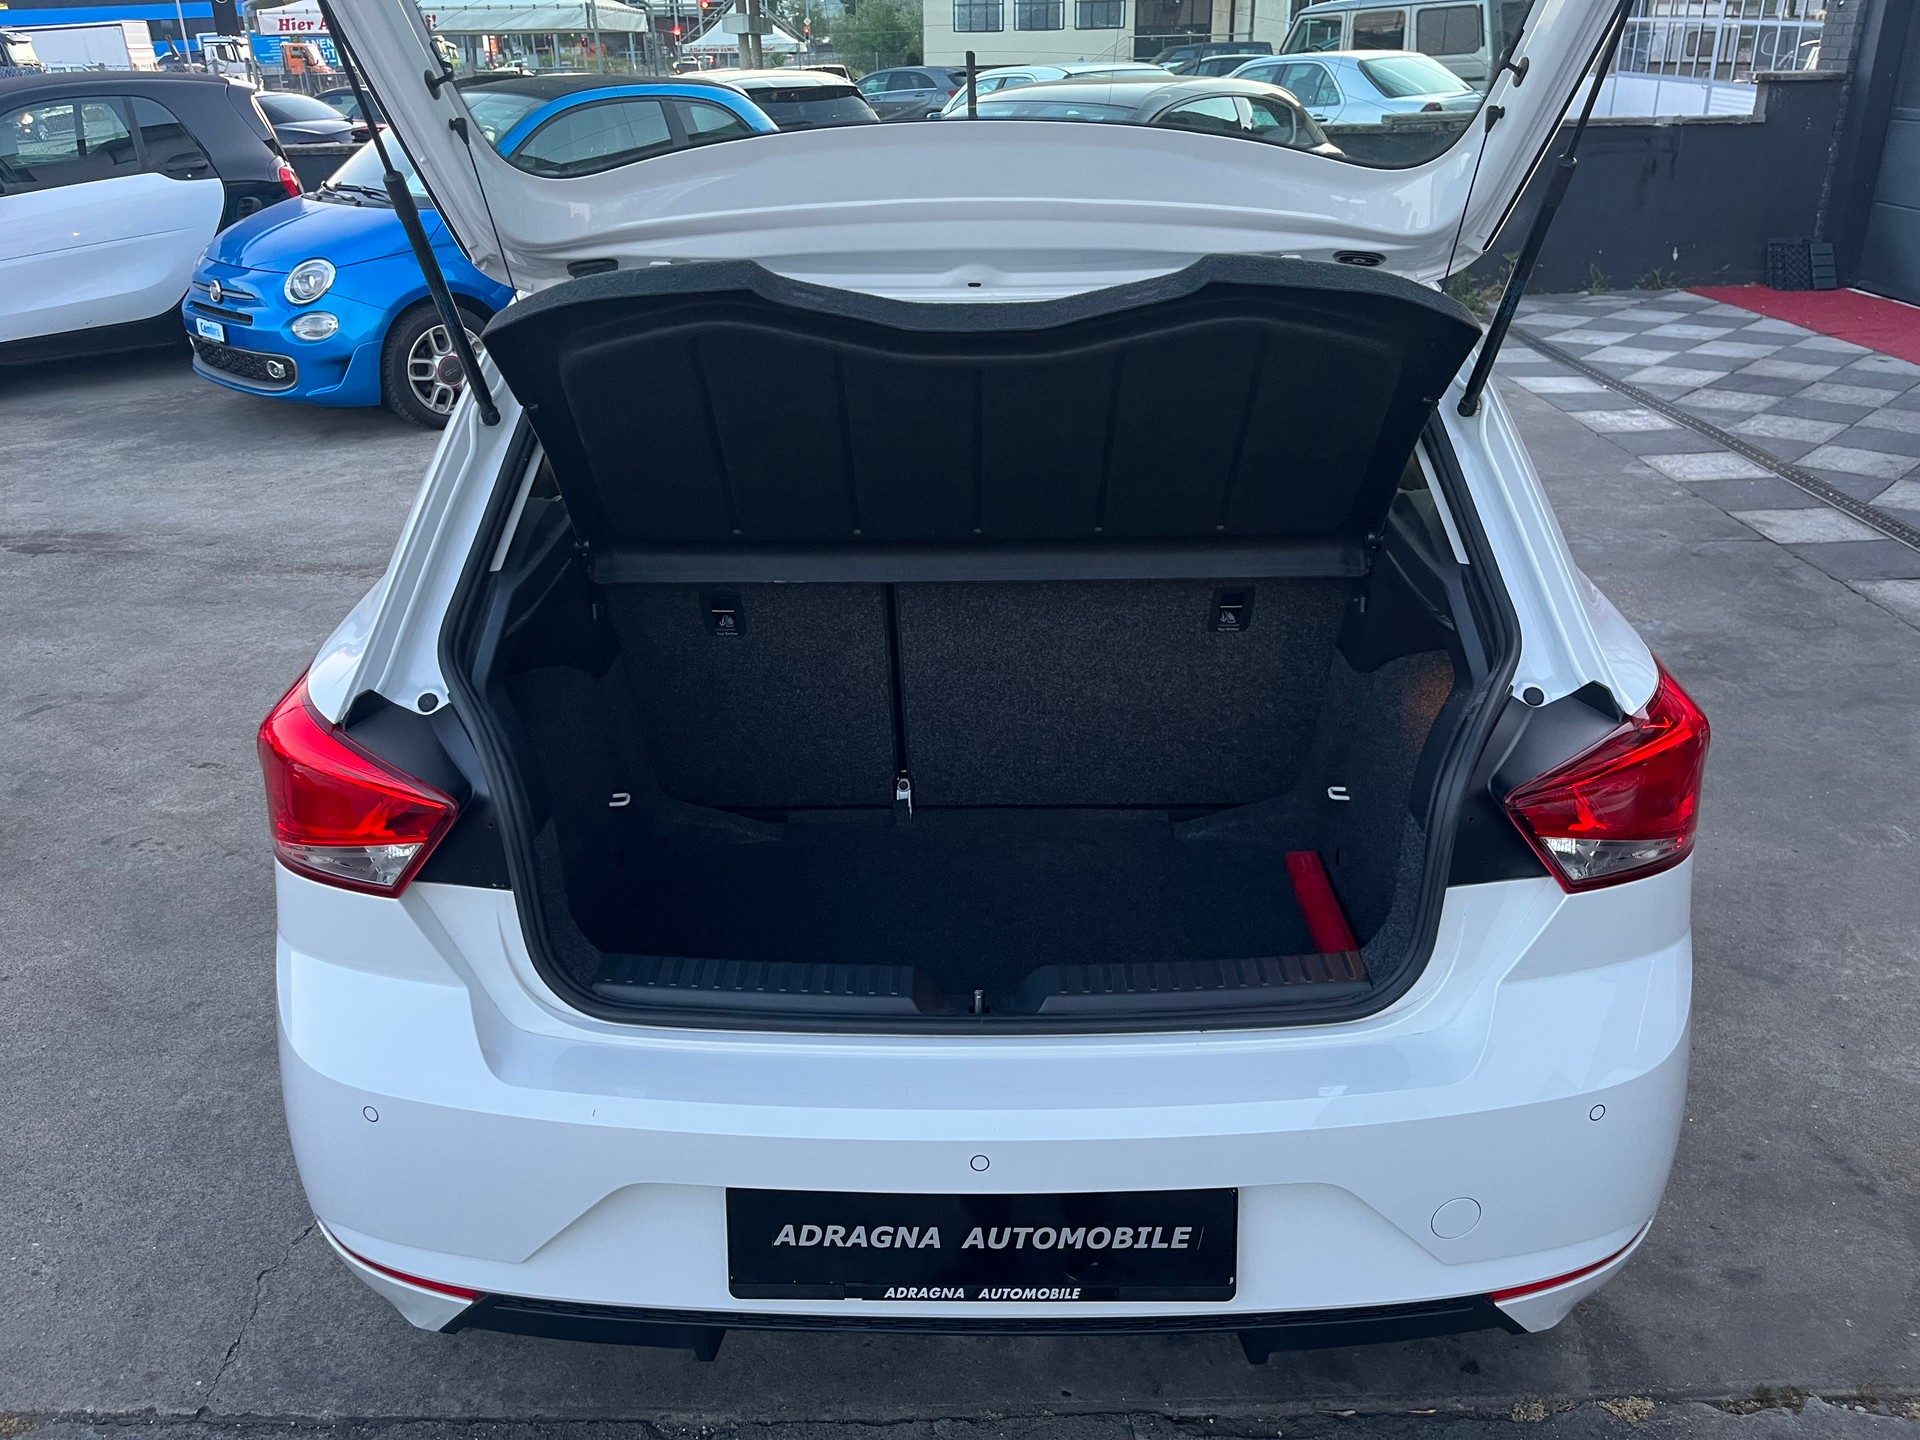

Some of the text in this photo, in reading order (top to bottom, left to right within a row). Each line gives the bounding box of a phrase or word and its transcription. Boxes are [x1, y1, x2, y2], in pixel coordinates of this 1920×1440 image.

[278, 17, 314, 31] Hier
[773, 1224, 1193, 1250] ADRAGNA AUTOMOBILE
[884, 1287, 1081, 1300] ADRAGNA AUTOMOBILE
